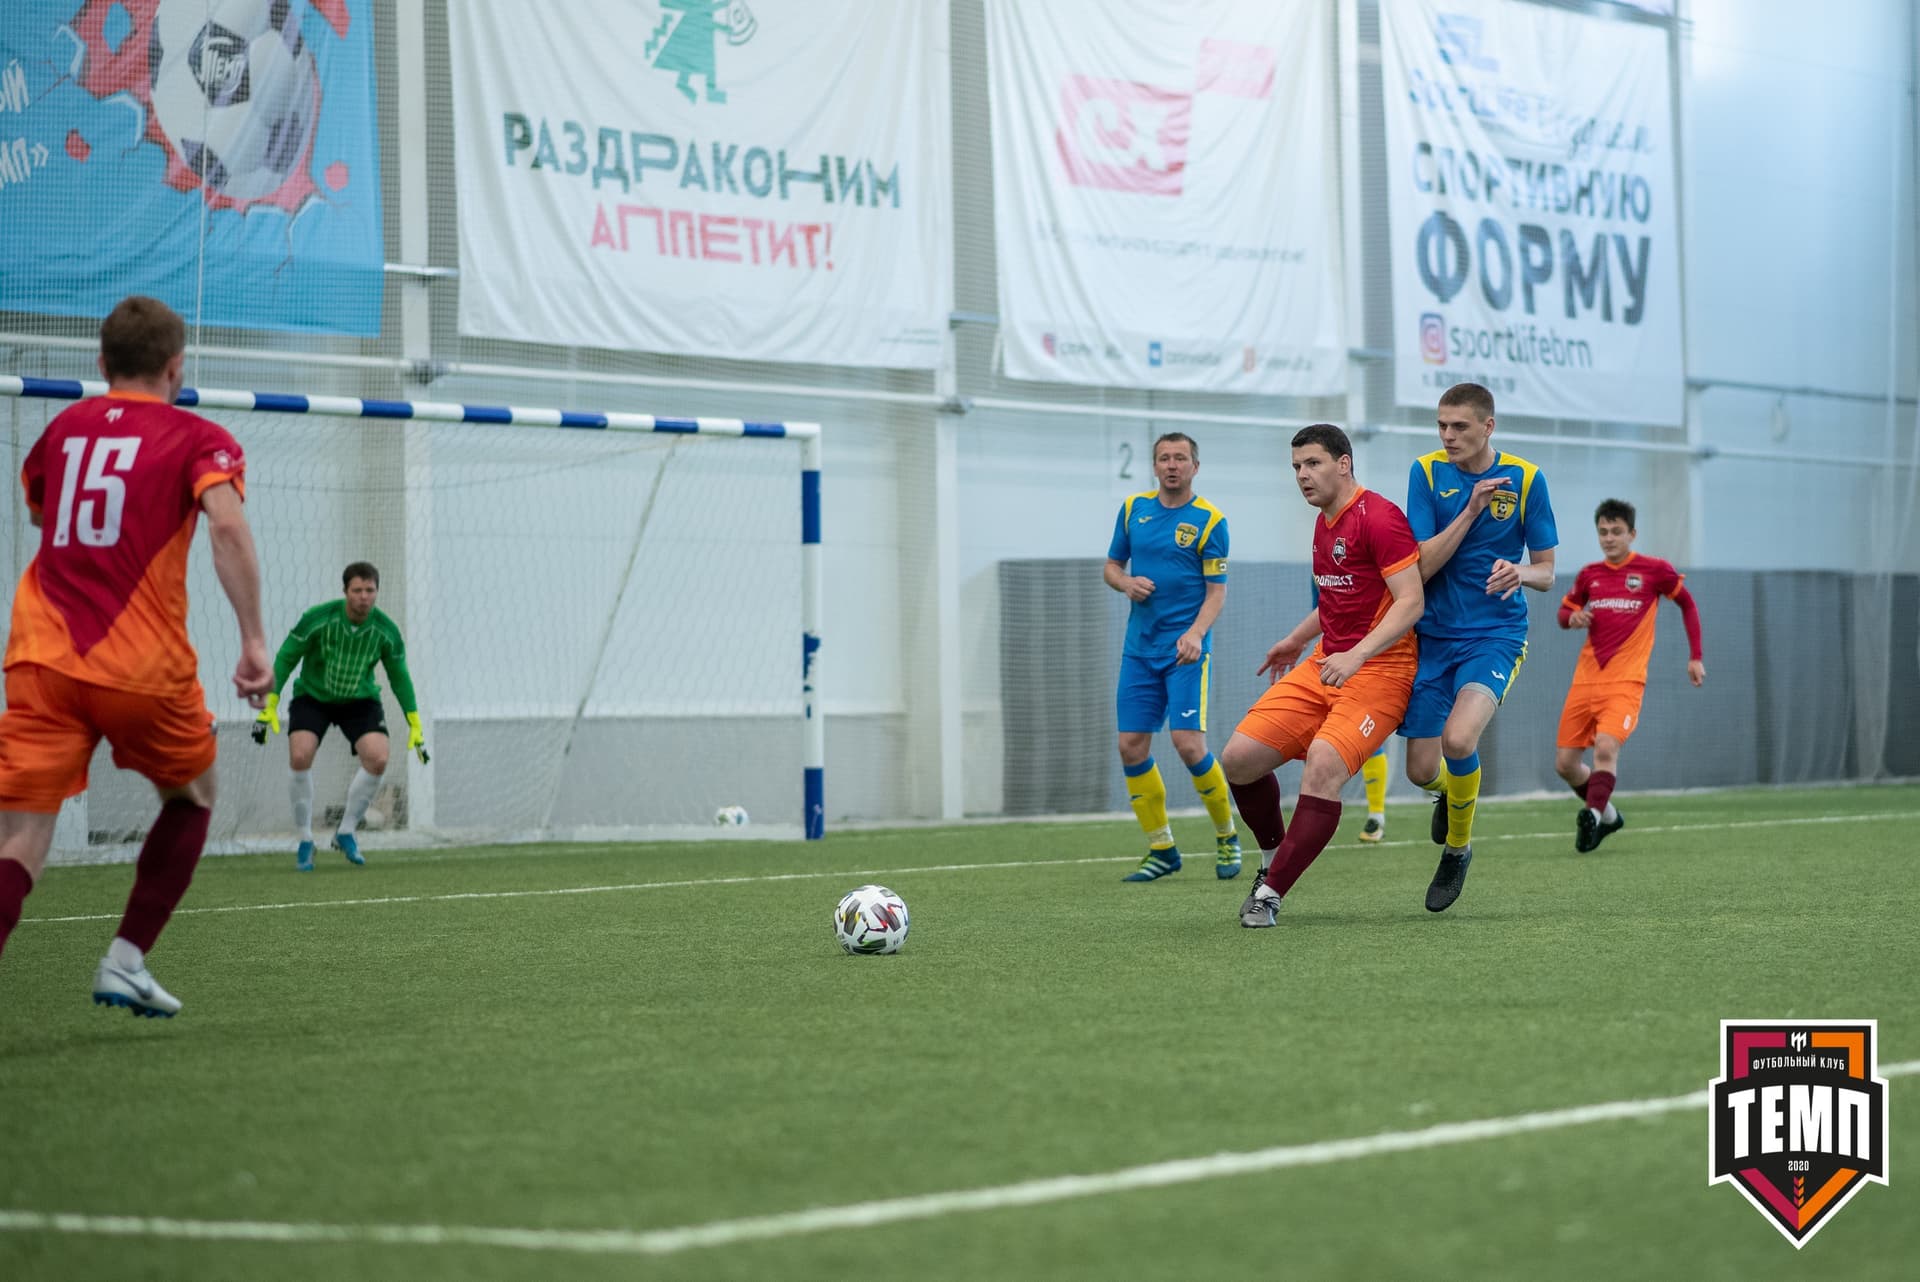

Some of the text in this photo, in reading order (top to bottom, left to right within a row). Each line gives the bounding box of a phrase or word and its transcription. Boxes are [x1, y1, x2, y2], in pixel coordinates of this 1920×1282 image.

[503, 111, 901, 208] РАЗДРАКОНИМ
[1413, 141, 1651, 223] СПОРТИВНУЮ
[591, 202, 834, 271] АППЕТИТ!
[1415, 210, 1651, 326] ФОРМУ
[53, 436, 142, 547] 15
[1118, 442, 1134, 480] 2
[1359, 714, 1375, 738] 13
